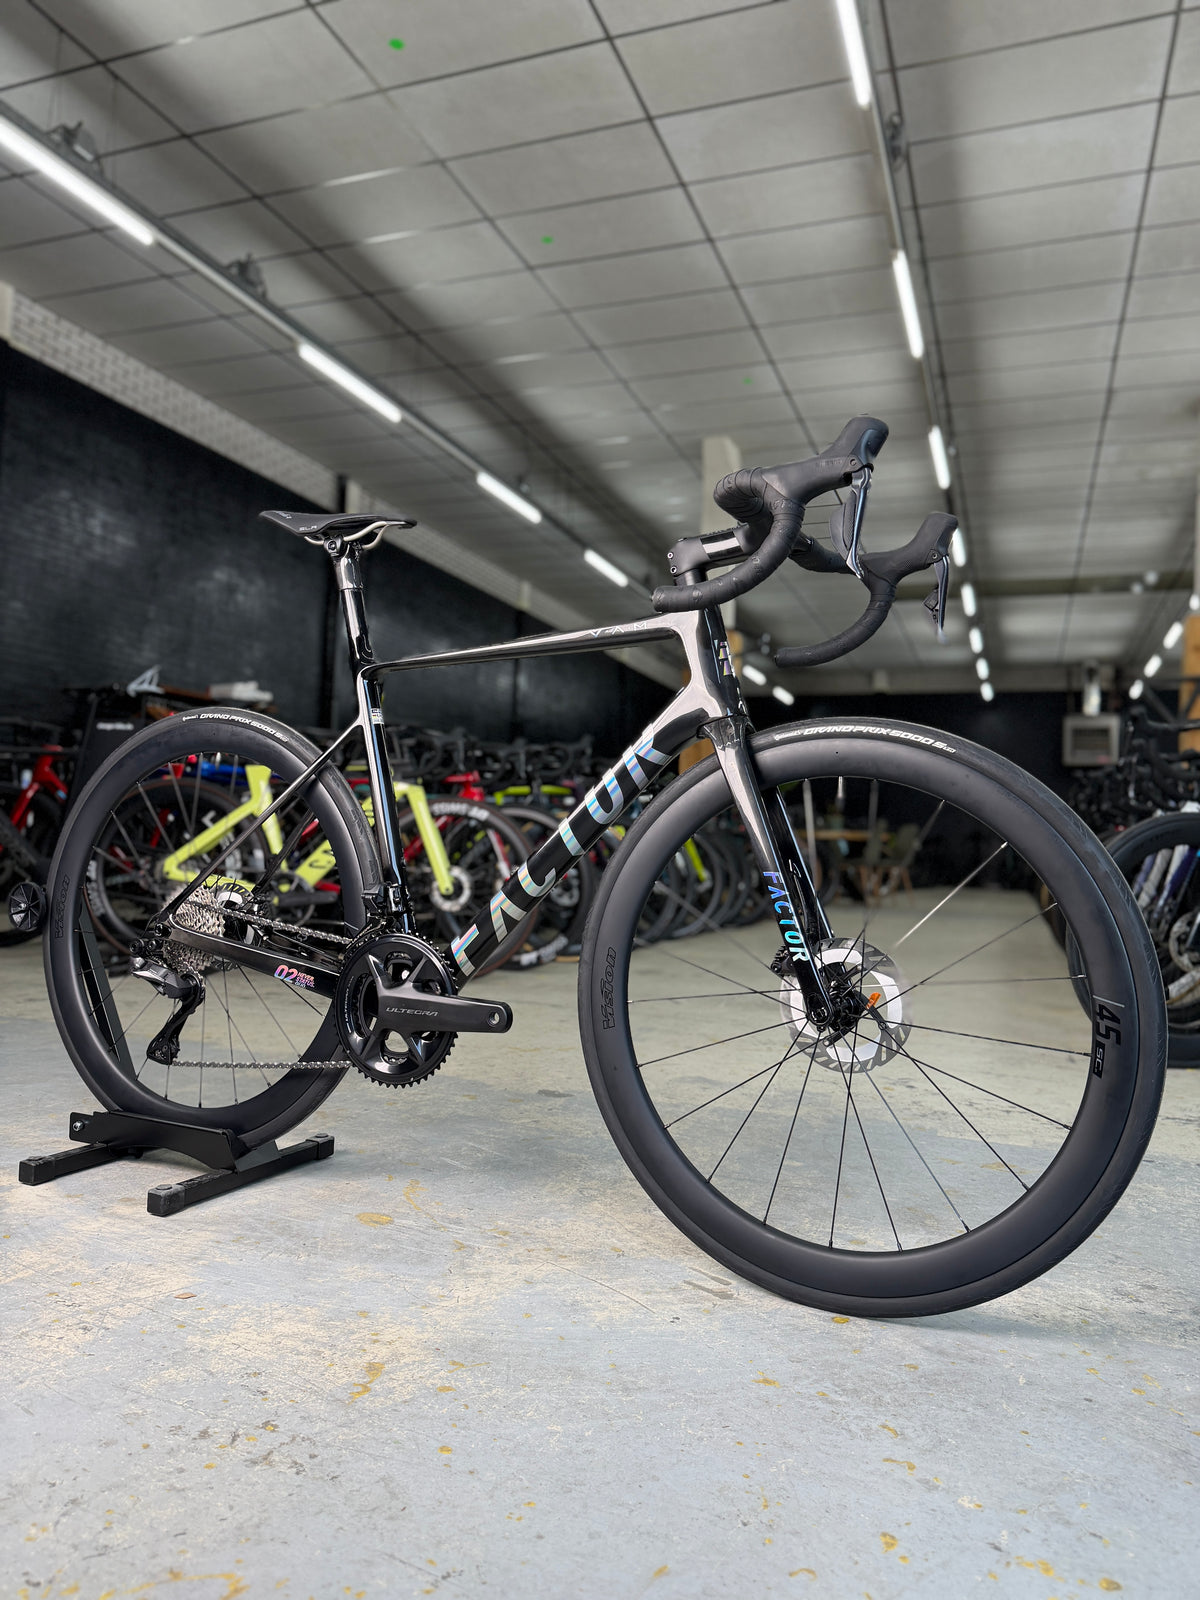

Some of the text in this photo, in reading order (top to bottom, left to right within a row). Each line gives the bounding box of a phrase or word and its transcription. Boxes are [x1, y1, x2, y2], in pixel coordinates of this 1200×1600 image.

[229, 715, 252, 725] PRIX
[251, 721, 275, 735] 5000
[803, 725, 853, 735] GRAND
[853, 726, 891, 736] PRIX
[889, 729, 935, 746] 5000
[54, 874, 71, 939] Vision
[763, 871, 811, 963] FACTOR
[600, 946, 617, 1030] Vision
[385, 1007, 438, 1018] ULTEGRA
[1096, 1003, 1122, 1046] 45
